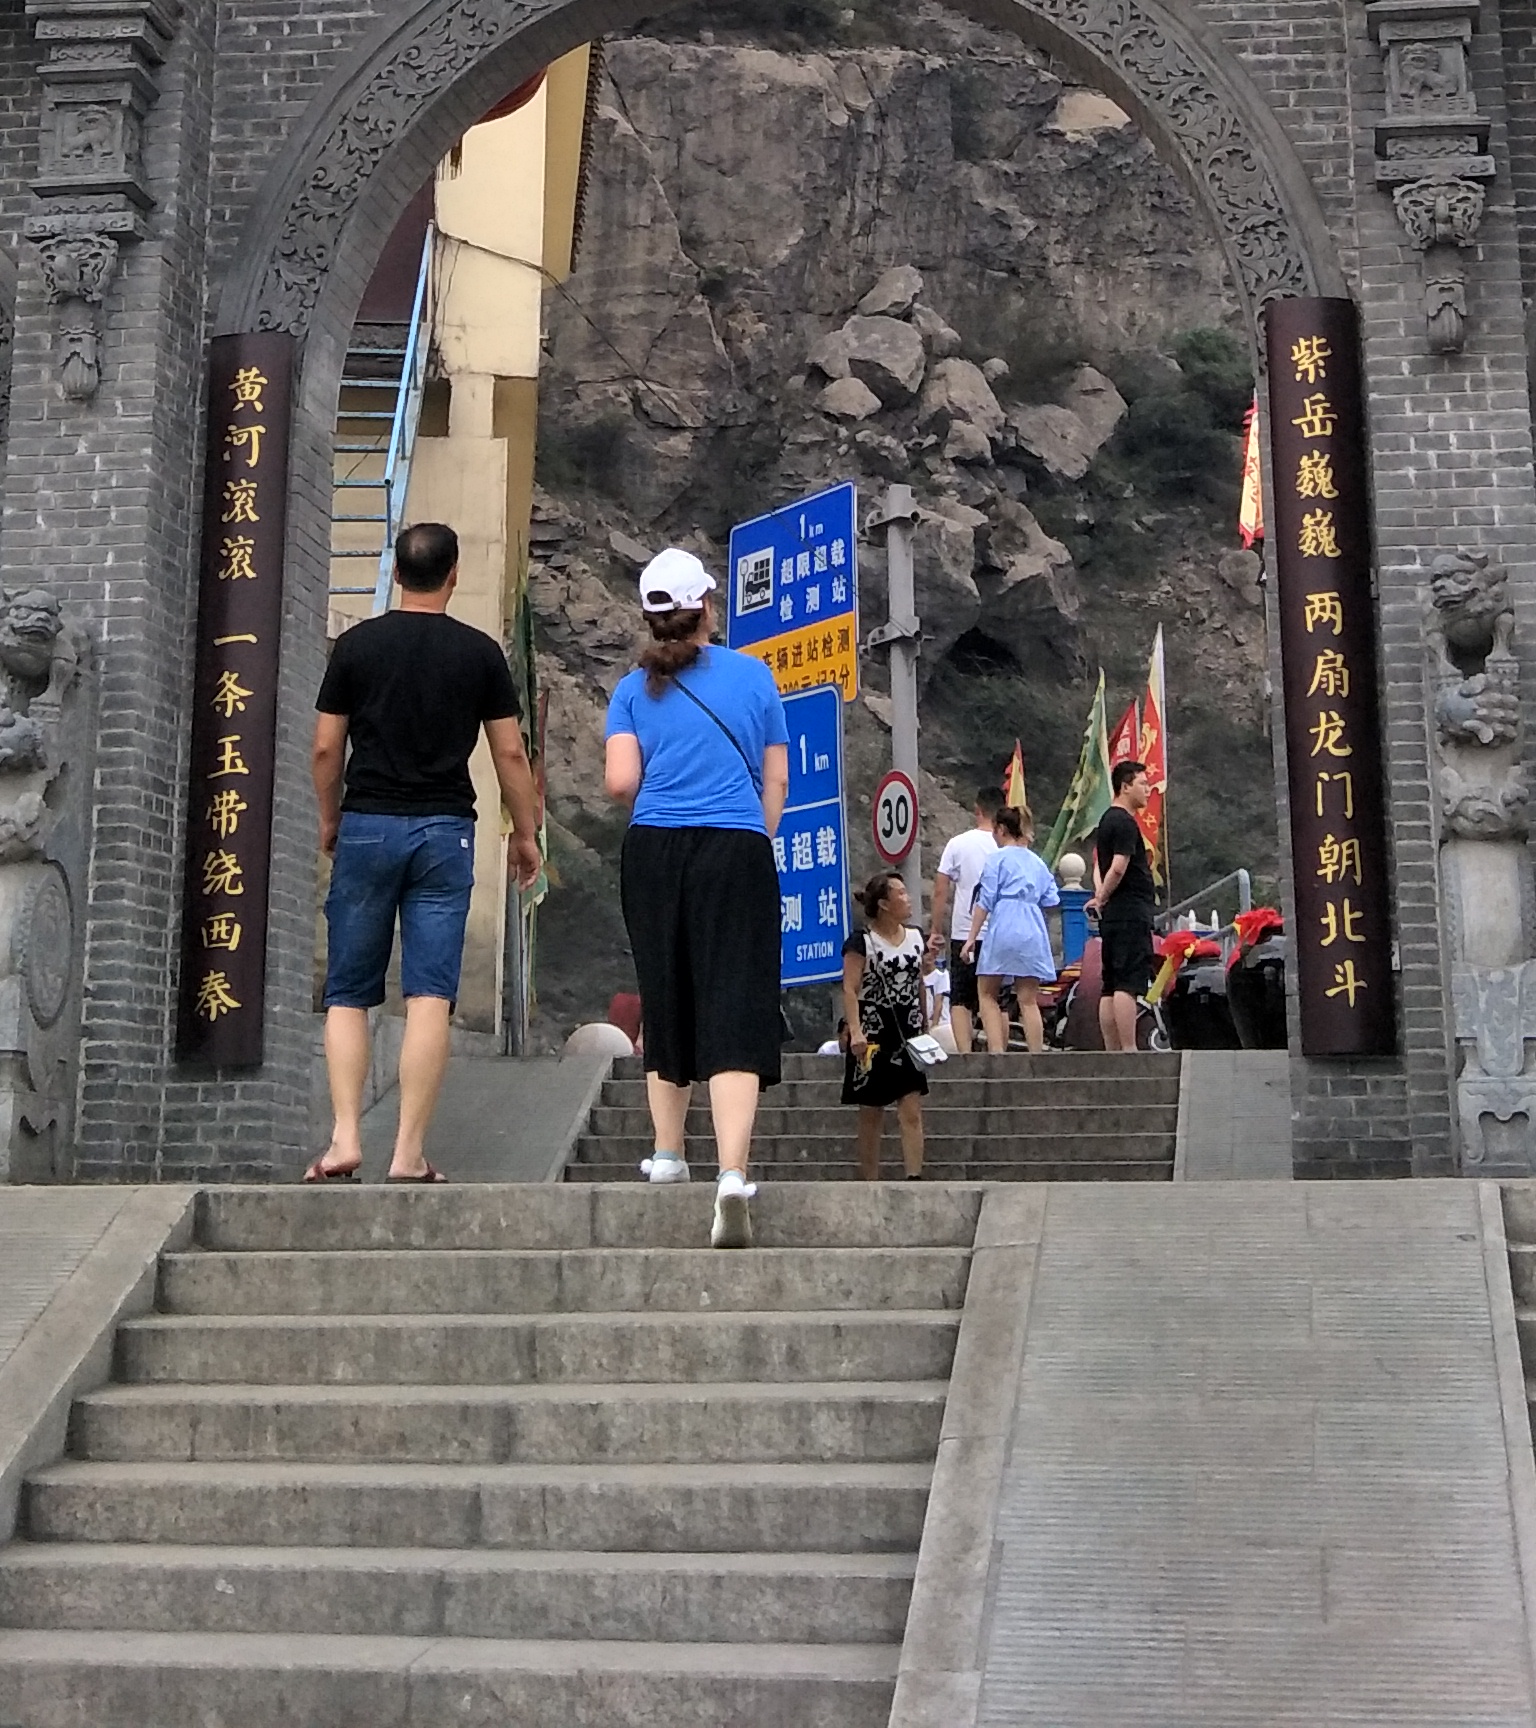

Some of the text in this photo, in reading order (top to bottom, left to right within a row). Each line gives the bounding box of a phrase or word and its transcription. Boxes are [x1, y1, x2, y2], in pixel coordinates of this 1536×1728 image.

[799, 513, 824, 541] 1 km
[780, 537, 846, 587] 超限超载
[780, 574, 847, 623] 检测站
[799, 733, 830, 775] 1 km
[881, 794, 909, 839] 30
[796, 940, 835, 962] STATION
